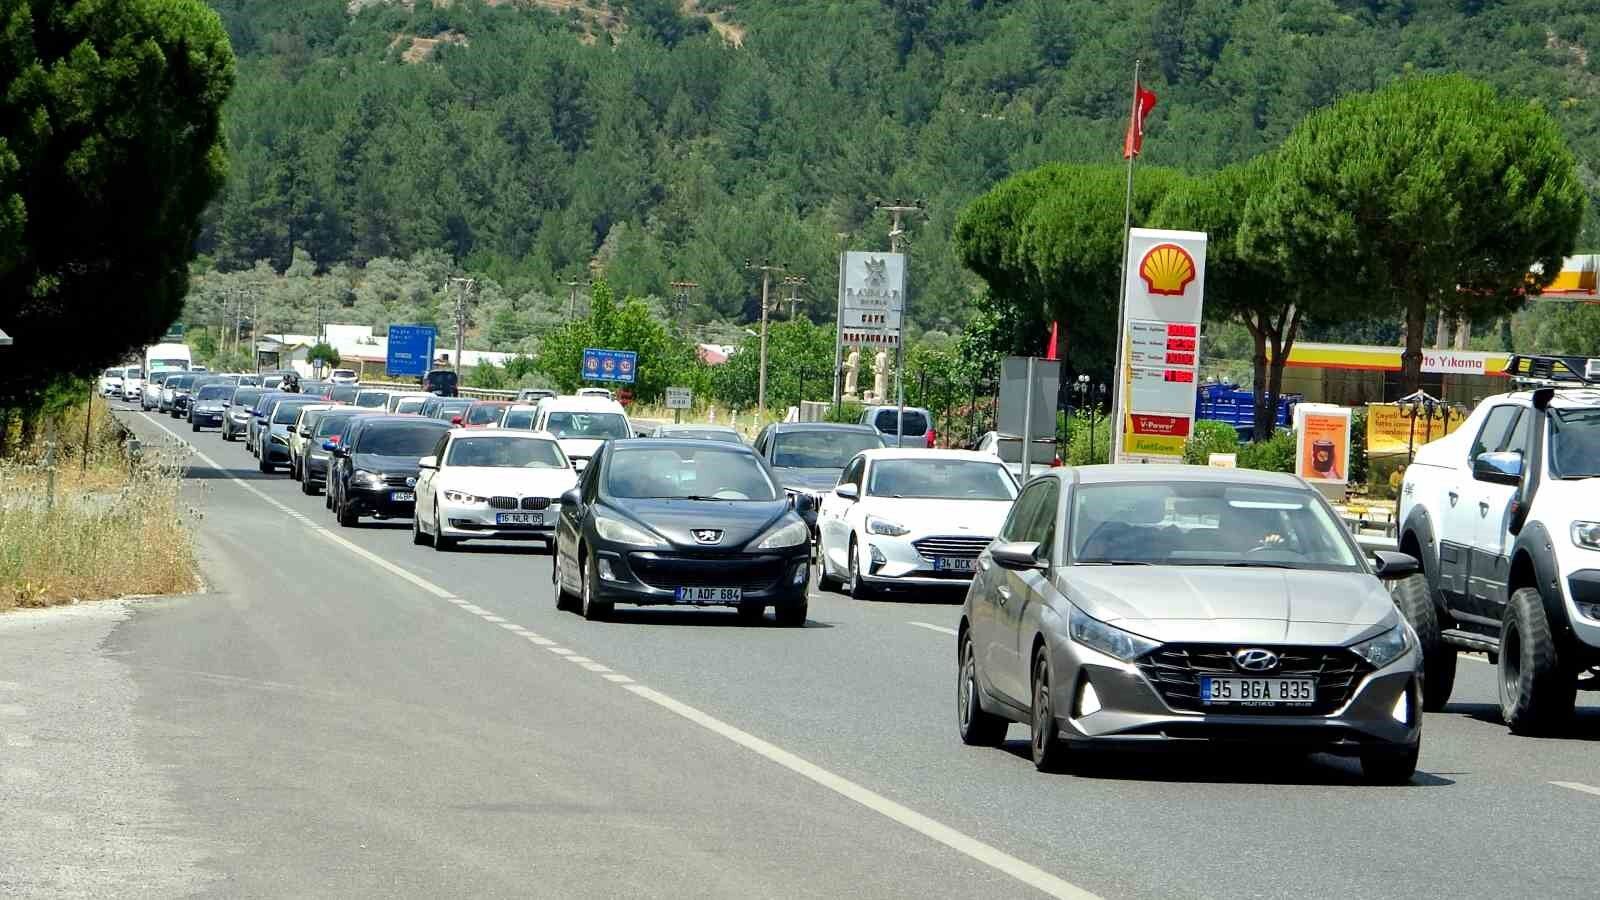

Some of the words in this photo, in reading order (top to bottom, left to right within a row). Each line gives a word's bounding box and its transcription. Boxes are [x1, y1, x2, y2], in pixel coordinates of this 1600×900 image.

[862, 314, 884, 323] CAFE
[844, 333, 898, 343] RESTAURANT
[1424, 356, 1435, 366] to
[720, 588, 739, 600] 684
[1212, 680, 1231, 698] 35
[1241, 680, 1271, 698] BGA
[1280, 681, 1310, 699] 835
